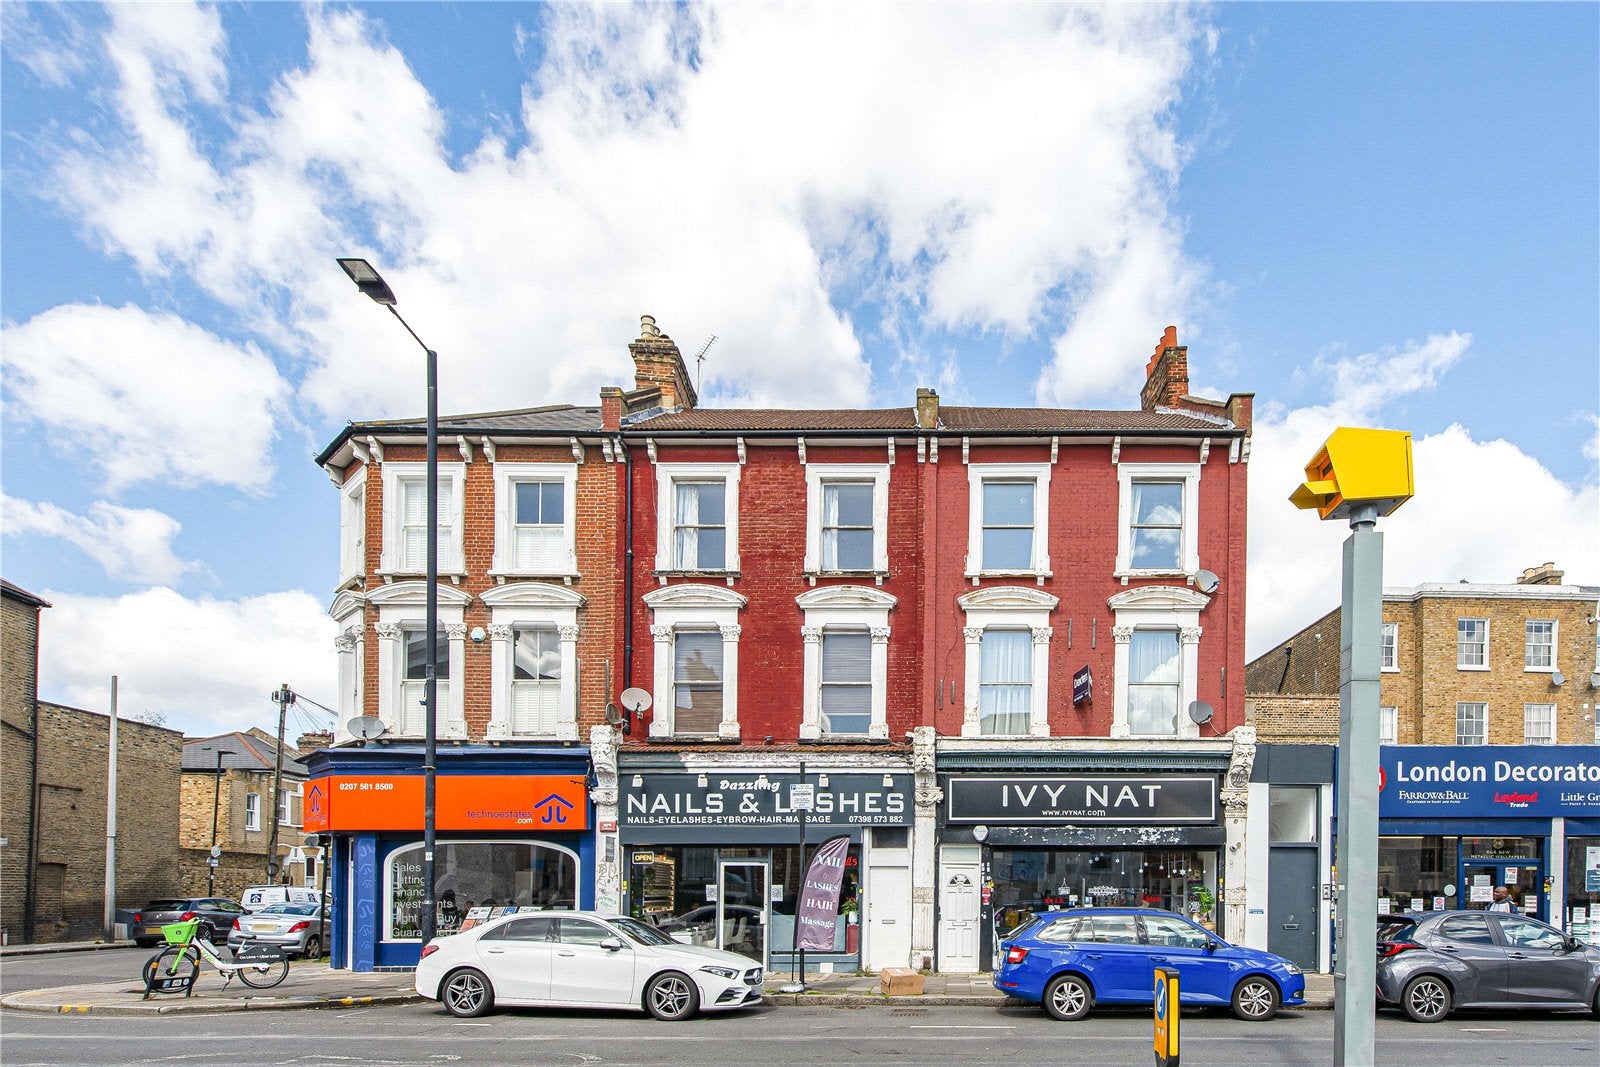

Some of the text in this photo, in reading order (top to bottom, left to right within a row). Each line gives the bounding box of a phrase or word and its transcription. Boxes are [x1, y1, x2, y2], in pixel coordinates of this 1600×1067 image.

[1398, 761, 1486, 782] London
[1494, 761, 1600, 782] Decorato
[1003, 784, 1161, 807] IVY NAT
[1561, 792, 1585, 801] Little
[628, 792, 904, 813] NAILS & LSHES
[467, 810, 533, 819] technoestates
[849, 815, 872, 823] 07398
[874, 815, 887, 823] 573
[889, 815, 903, 823] 882
[393, 863, 421, 872] Sales
[817, 854, 843, 868] NAIL
[806, 880, 840, 892] LASHES
[806, 898, 834, 911] HAIR
[800, 916, 835, 929] Massage
